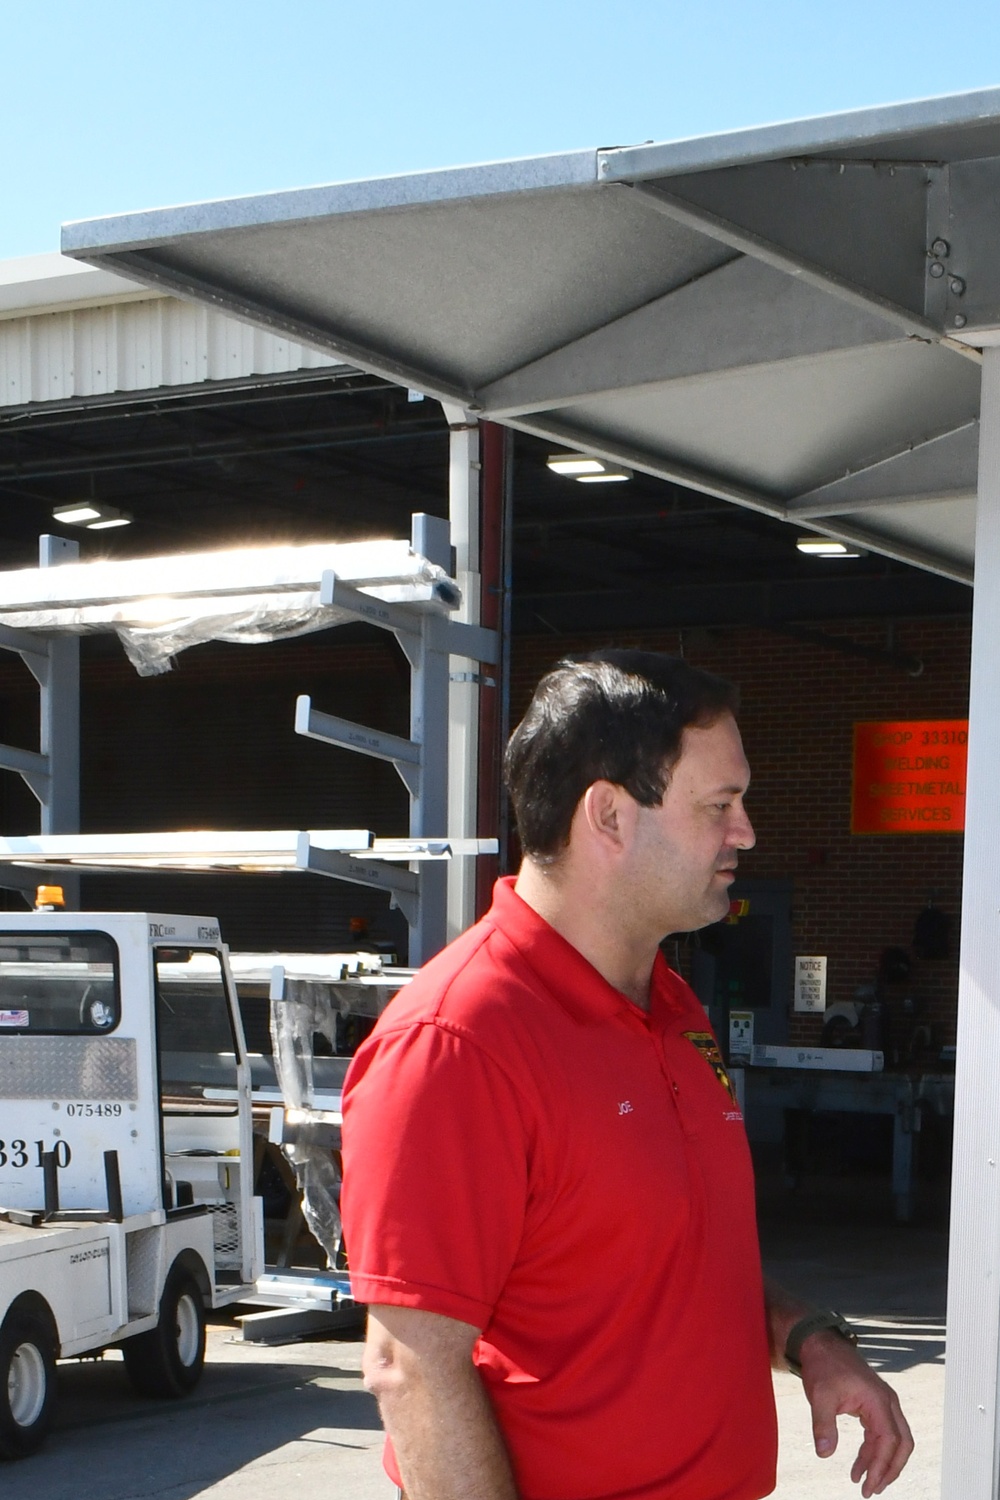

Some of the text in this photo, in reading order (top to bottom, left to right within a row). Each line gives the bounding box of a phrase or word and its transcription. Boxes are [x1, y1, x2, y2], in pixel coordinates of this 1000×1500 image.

[872, 730, 968, 746] SHOP 33310
[884, 756, 950, 771] WELDING
[880, 808, 953, 822] SERVICES
[149, 923, 164, 938] FRC
[799, 961, 822, 971] NOTICE
[66, 1103, 122, 1118] 075489
[617, 1100, 634, 1116] JOE
